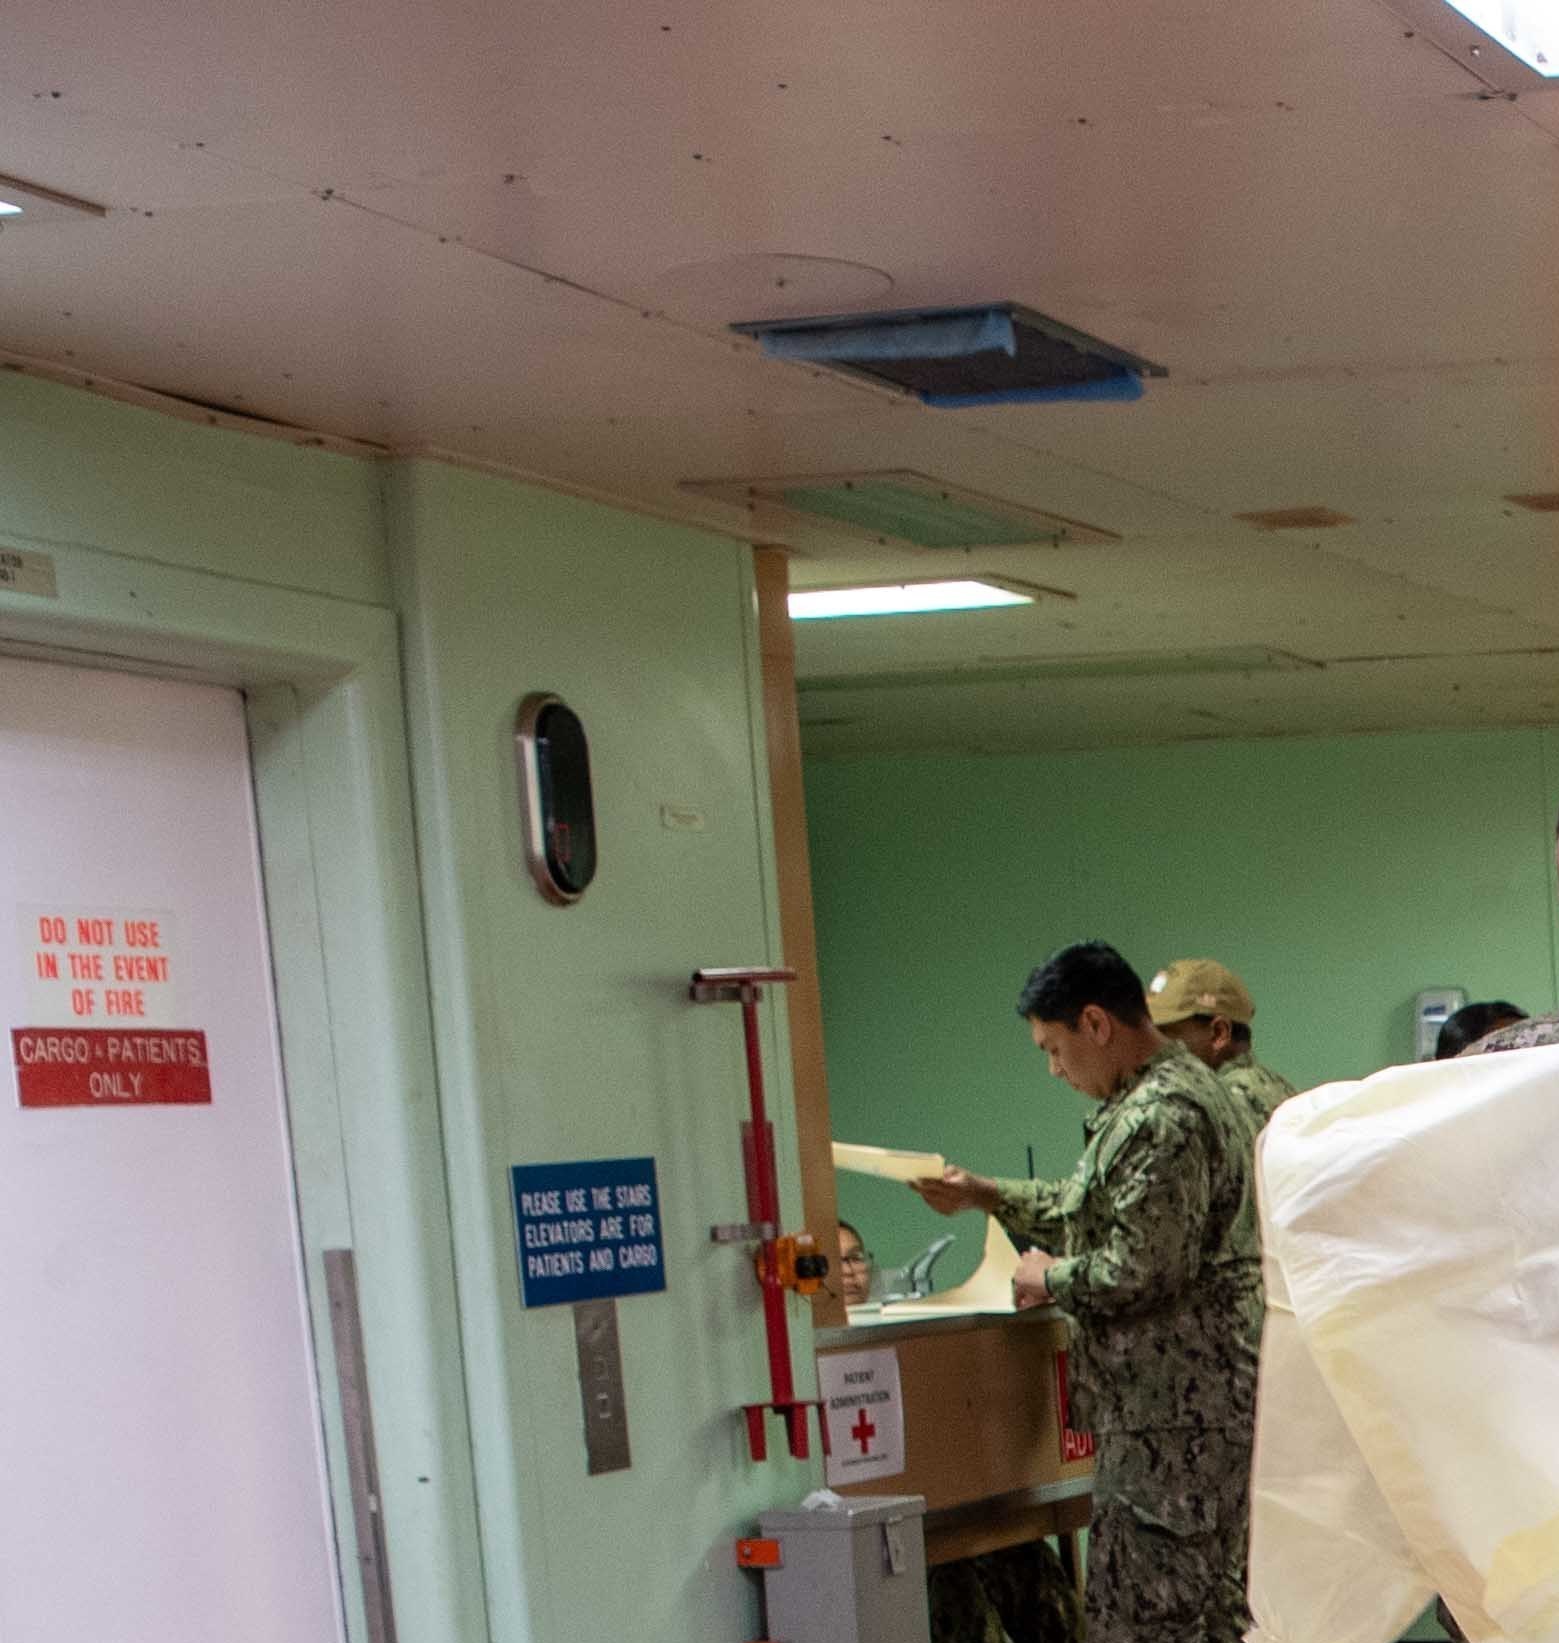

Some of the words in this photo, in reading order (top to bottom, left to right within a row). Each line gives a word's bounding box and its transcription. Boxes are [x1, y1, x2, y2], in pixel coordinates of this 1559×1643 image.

[39, 916, 67, 944] DO
[77, 917, 113, 945] NOT
[124, 920, 160, 948] USE
[36, 952, 59, 979] IN
[68, 953, 104, 981] THE
[113, 955, 169, 982] EVENT
[71, 988, 95, 1016] OF
[104, 989, 145, 1017] FIRE
[19, 1036, 89, 1064] CARGO
[107, 1036, 201, 1066] PATIENTS
[88, 1071, 144, 1098] ONLY
[521, 1190, 562, 1216] PLEASE
[565, 1187, 588, 1213] USE
[591, 1185, 613, 1210] THE
[615, 1184, 652, 1208] STAIRS
[524, 1219, 595, 1248] ELEVATORS
[600, 1215, 624, 1240] ARE
[629, 1213, 655, 1237] FOR
[527, 1250, 585, 1278] PATIENTS
[589, 1246, 614, 1272] AND
[618, 1244, 657, 1269] CARGO
